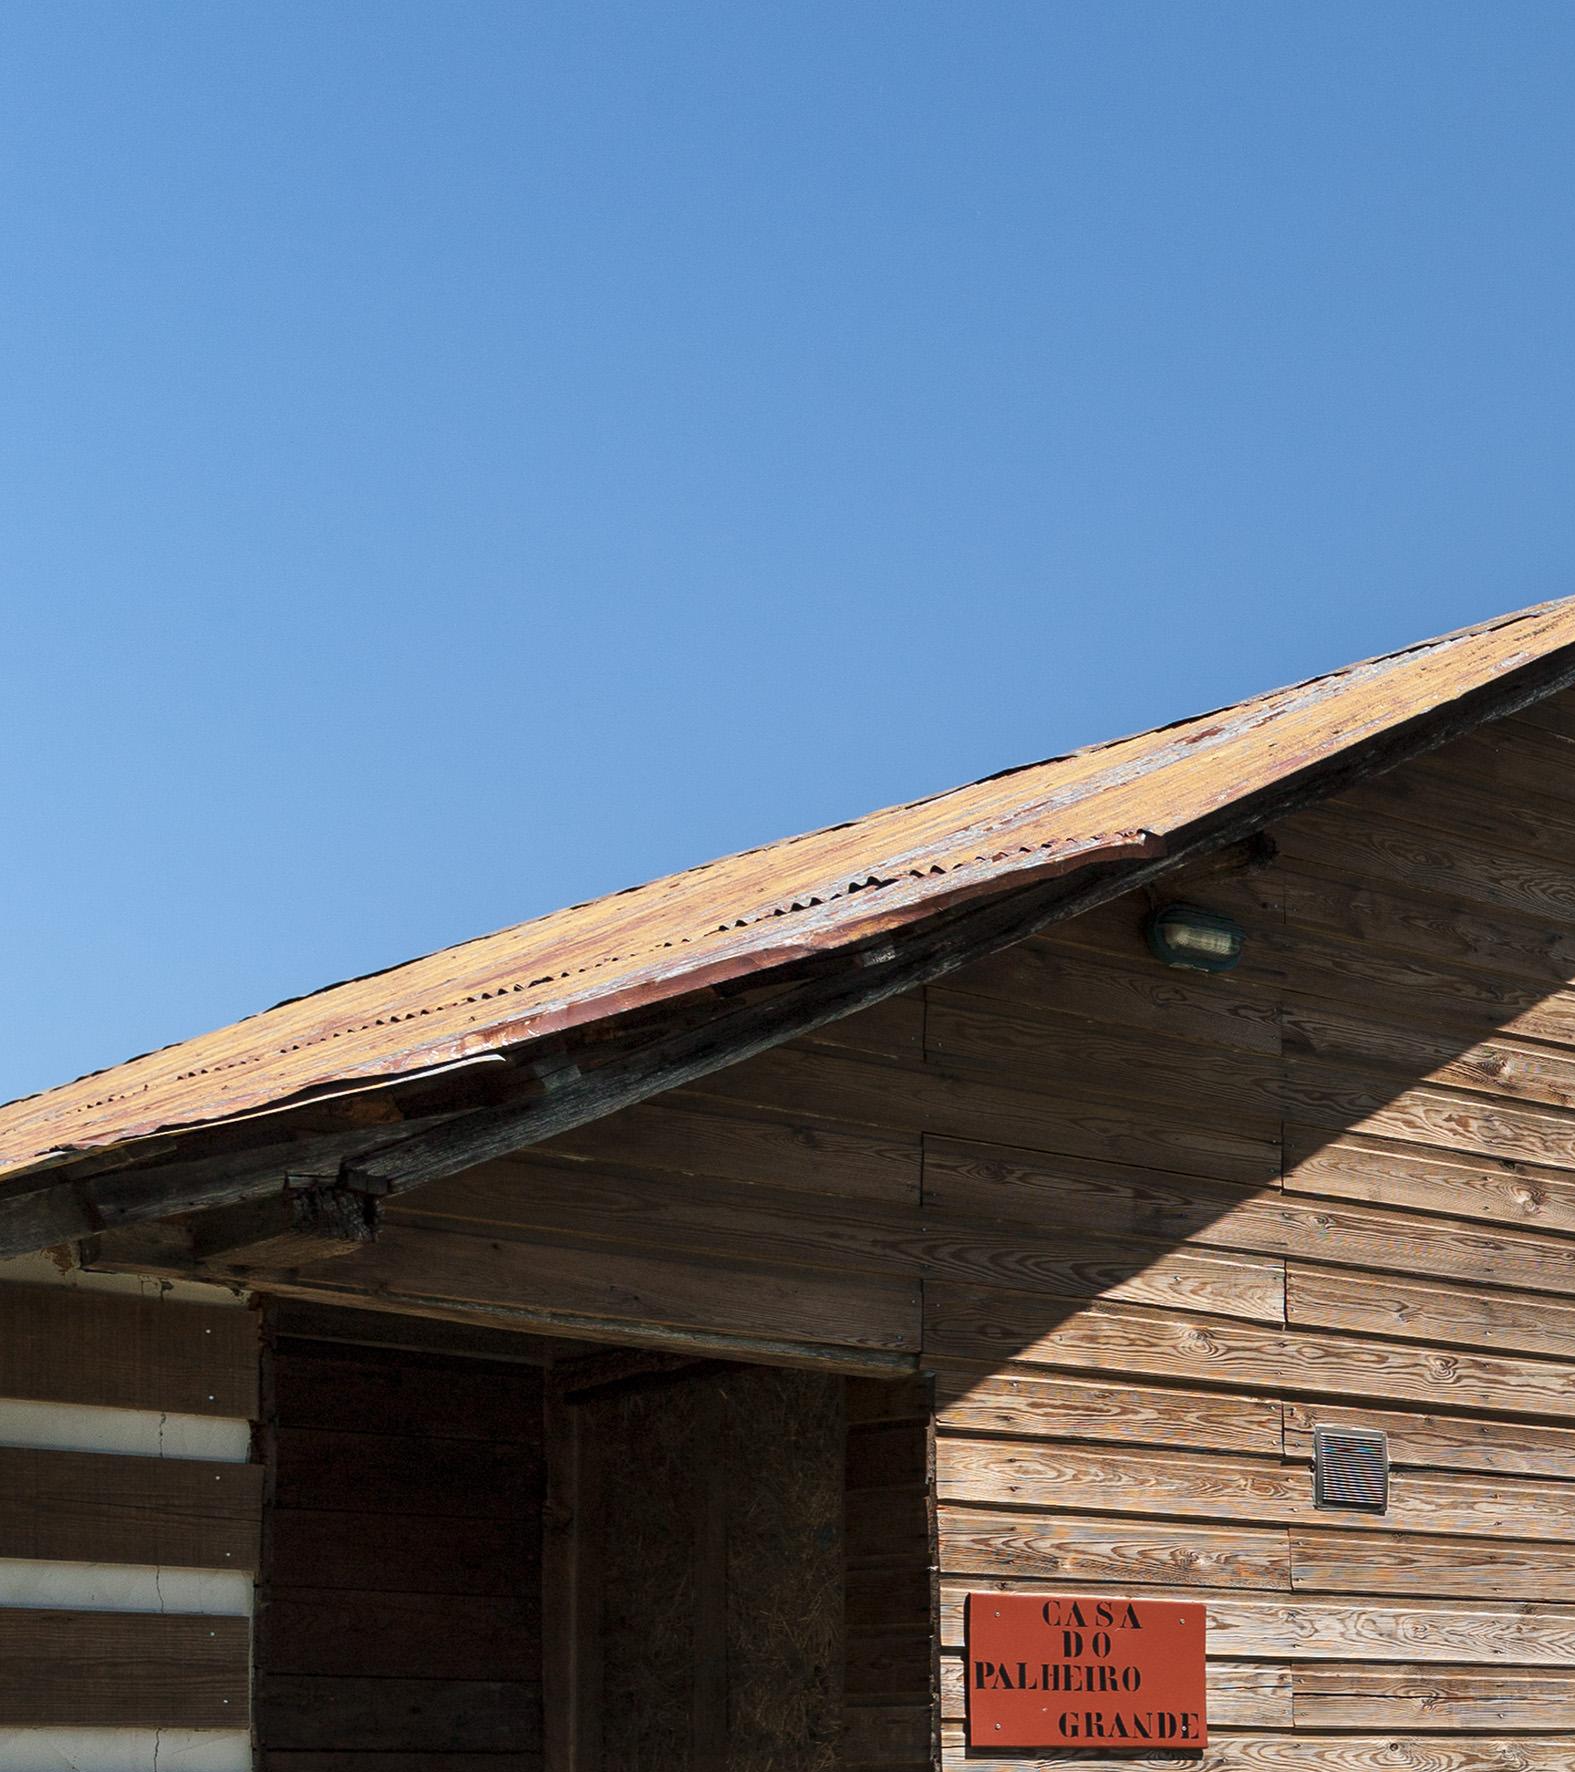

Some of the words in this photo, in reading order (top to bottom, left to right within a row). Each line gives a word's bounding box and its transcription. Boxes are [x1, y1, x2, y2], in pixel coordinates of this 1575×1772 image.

[1042, 1600, 1142, 1630] CASA
[1062, 1630, 1111, 1658] DO
[973, 1660, 1141, 1692] PALHEIRO
[1058, 1711, 1199, 1740] GRANDE
